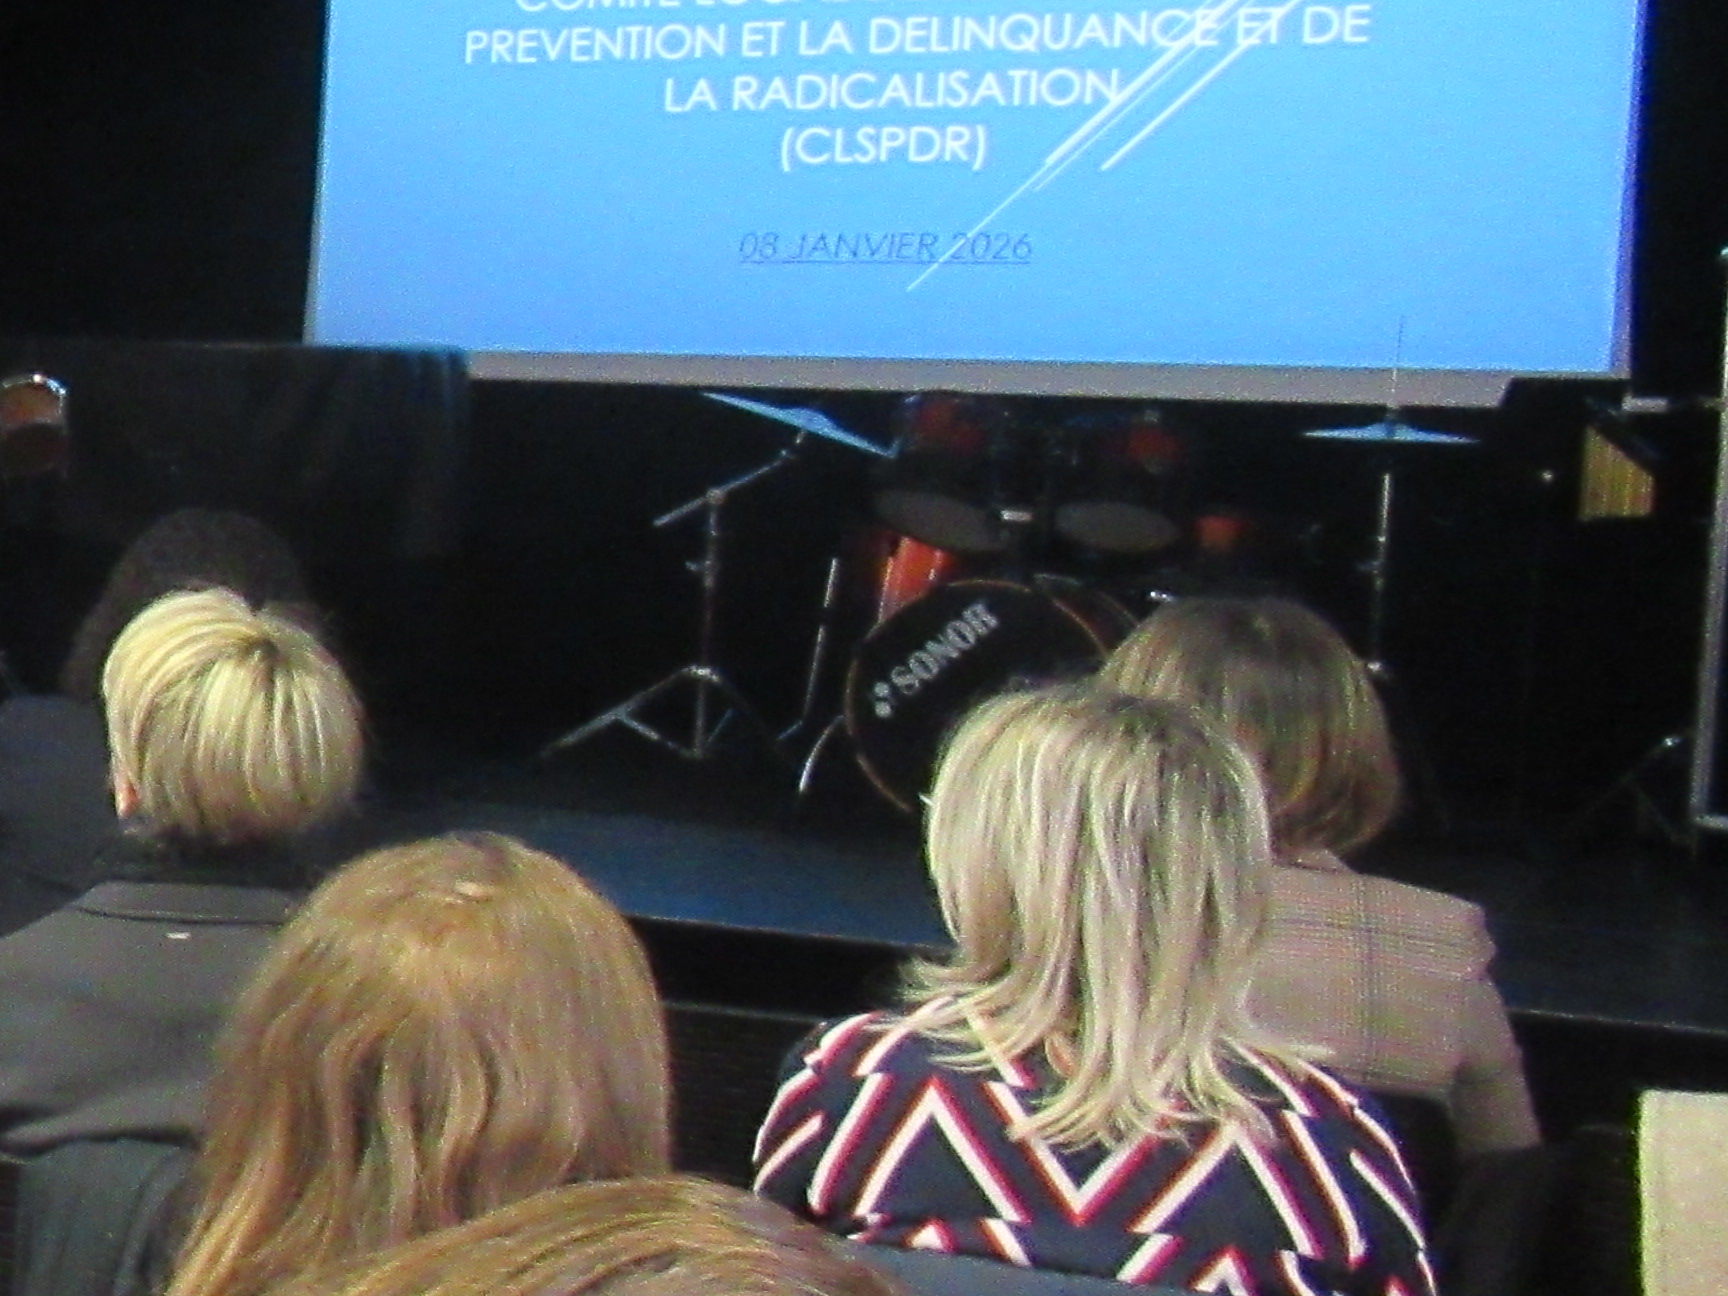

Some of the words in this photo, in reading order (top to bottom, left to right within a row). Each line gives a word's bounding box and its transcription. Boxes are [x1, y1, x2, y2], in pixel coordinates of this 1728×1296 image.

[466, 25, 728, 64] PREVENTION
[742, 22, 785, 58] ET
[797, 18, 851, 55] LA
[869, 8, 1217, 55] DELINQUANCE
[1235, 7, 1286, 46] ET
[1301, 2, 1372, 44] DE
[664, 74, 716, 114] LA
[731, 67, 1121, 112] RADICALISATION
[779, 122, 988, 172] (CLSPDR)
[738, 230, 779, 262] 08
[785, 230, 938, 263] JANVIER
[952, 229, 1032, 263] 2026
[890, 602, 999, 696] SONOR
